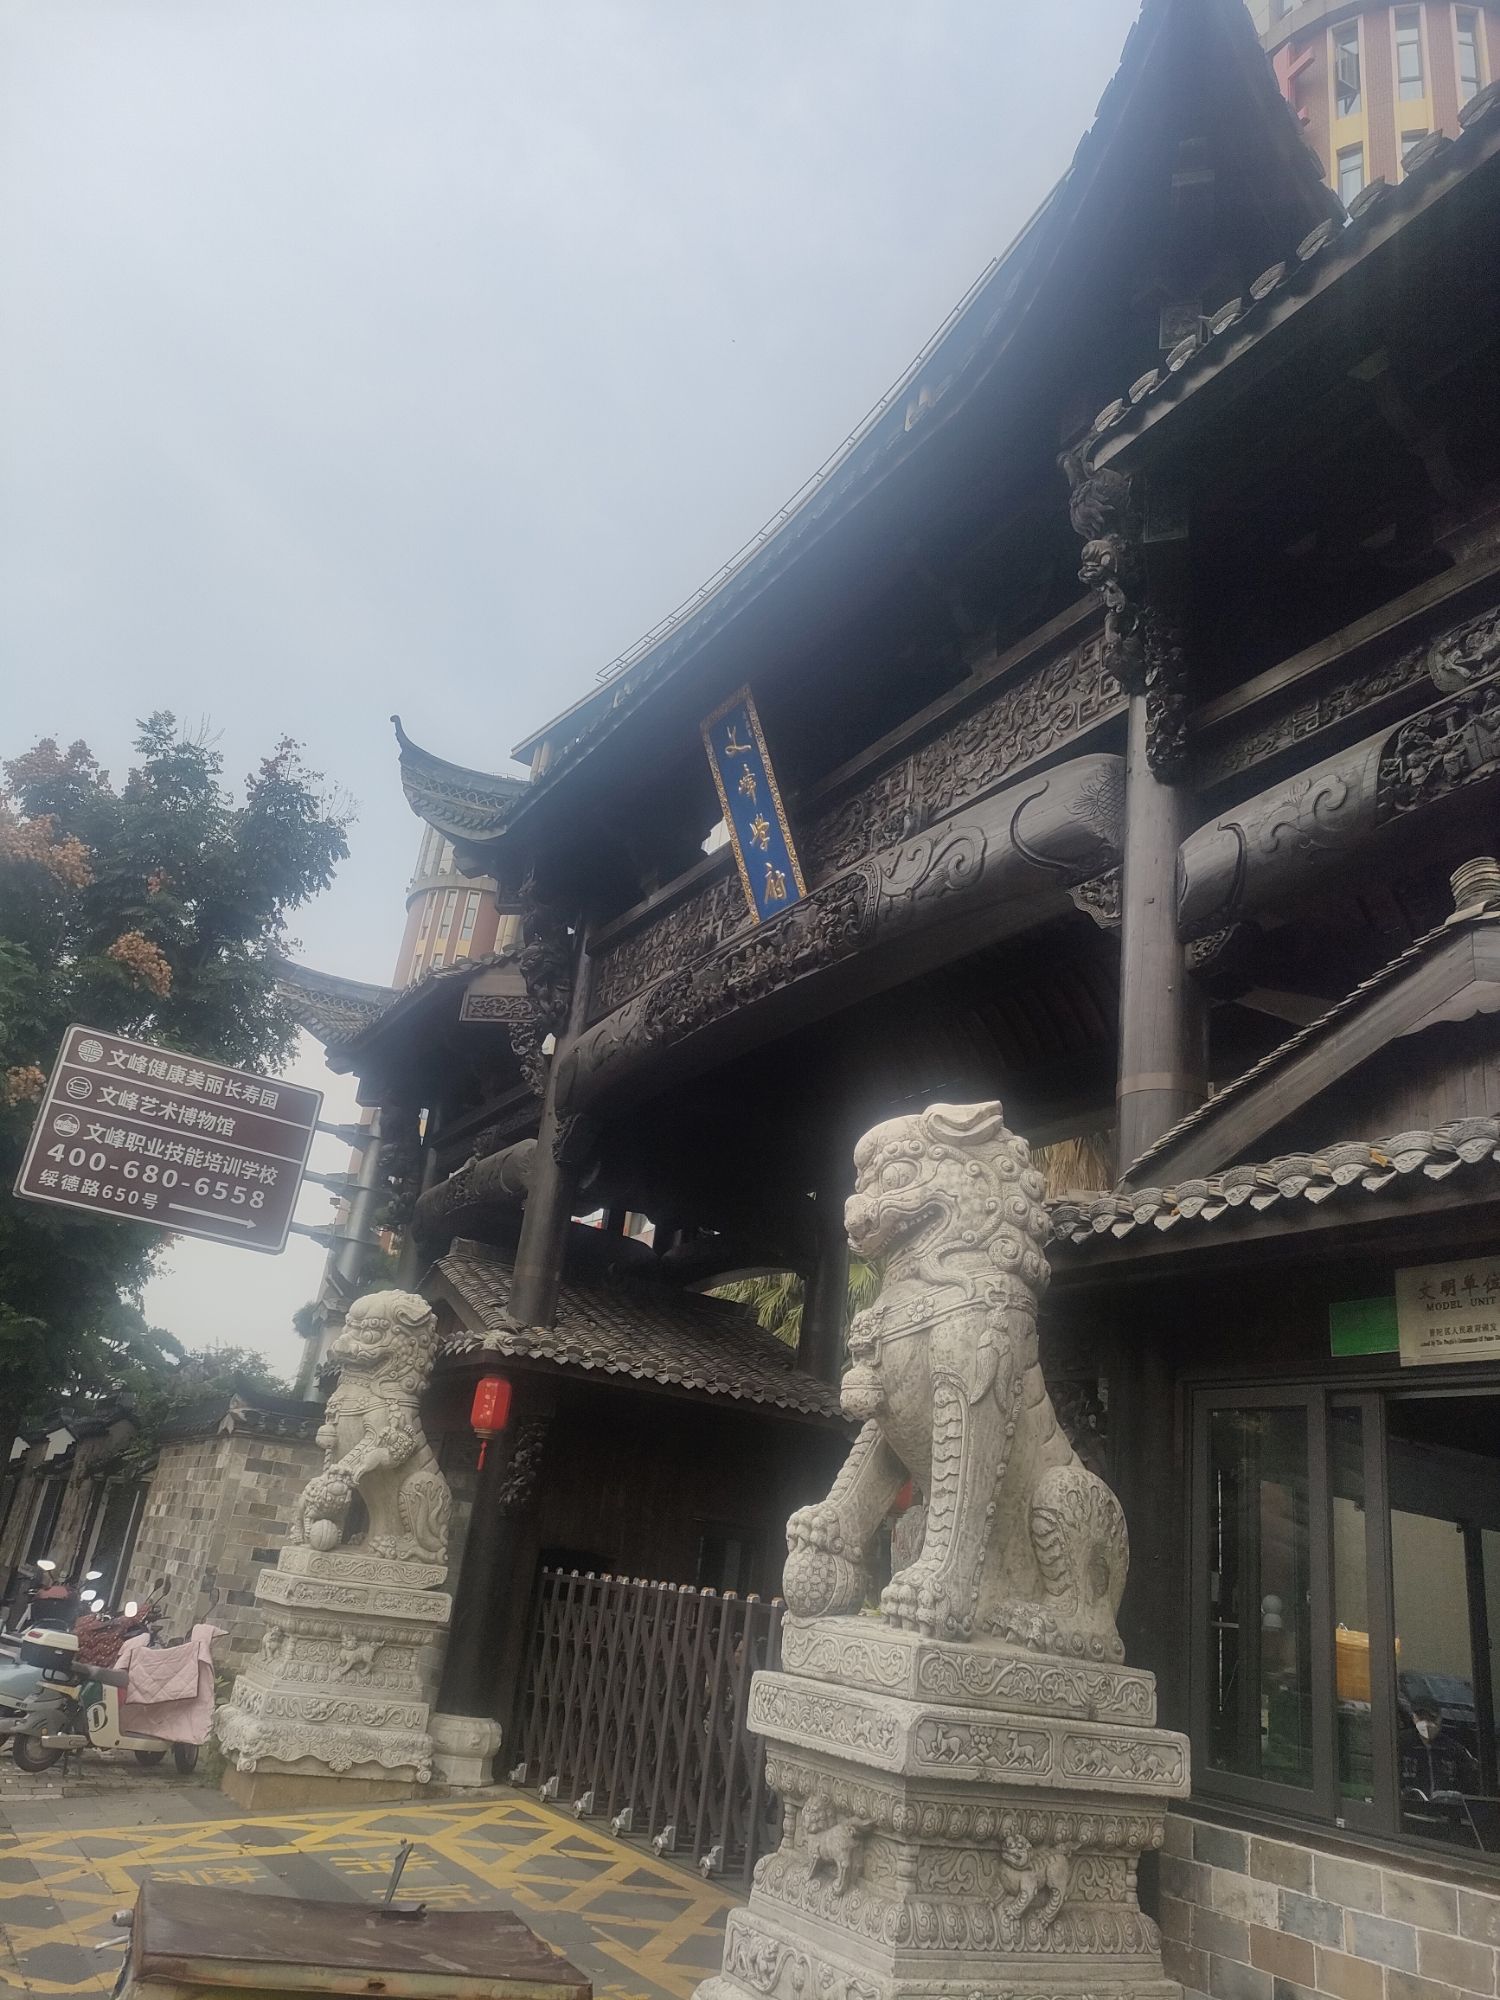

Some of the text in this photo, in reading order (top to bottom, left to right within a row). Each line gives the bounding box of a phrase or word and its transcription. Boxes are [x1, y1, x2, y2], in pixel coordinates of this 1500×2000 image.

[107, 1049, 279, 1110] 文峰健康美丽长寿园
[97, 1086, 236, 1136] 文峰艺术博物馆
[47, 1143, 265, 1209] 400-680-6558
[83, 1123, 278, 1187] 文峰职业技能培训学校
[39, 1169, 158, 1210] 绥德路650号
[1418, 1273, 1500, 1299] 文明单位
[1427, 1297, 1496, 1312] MODEL UNIT
